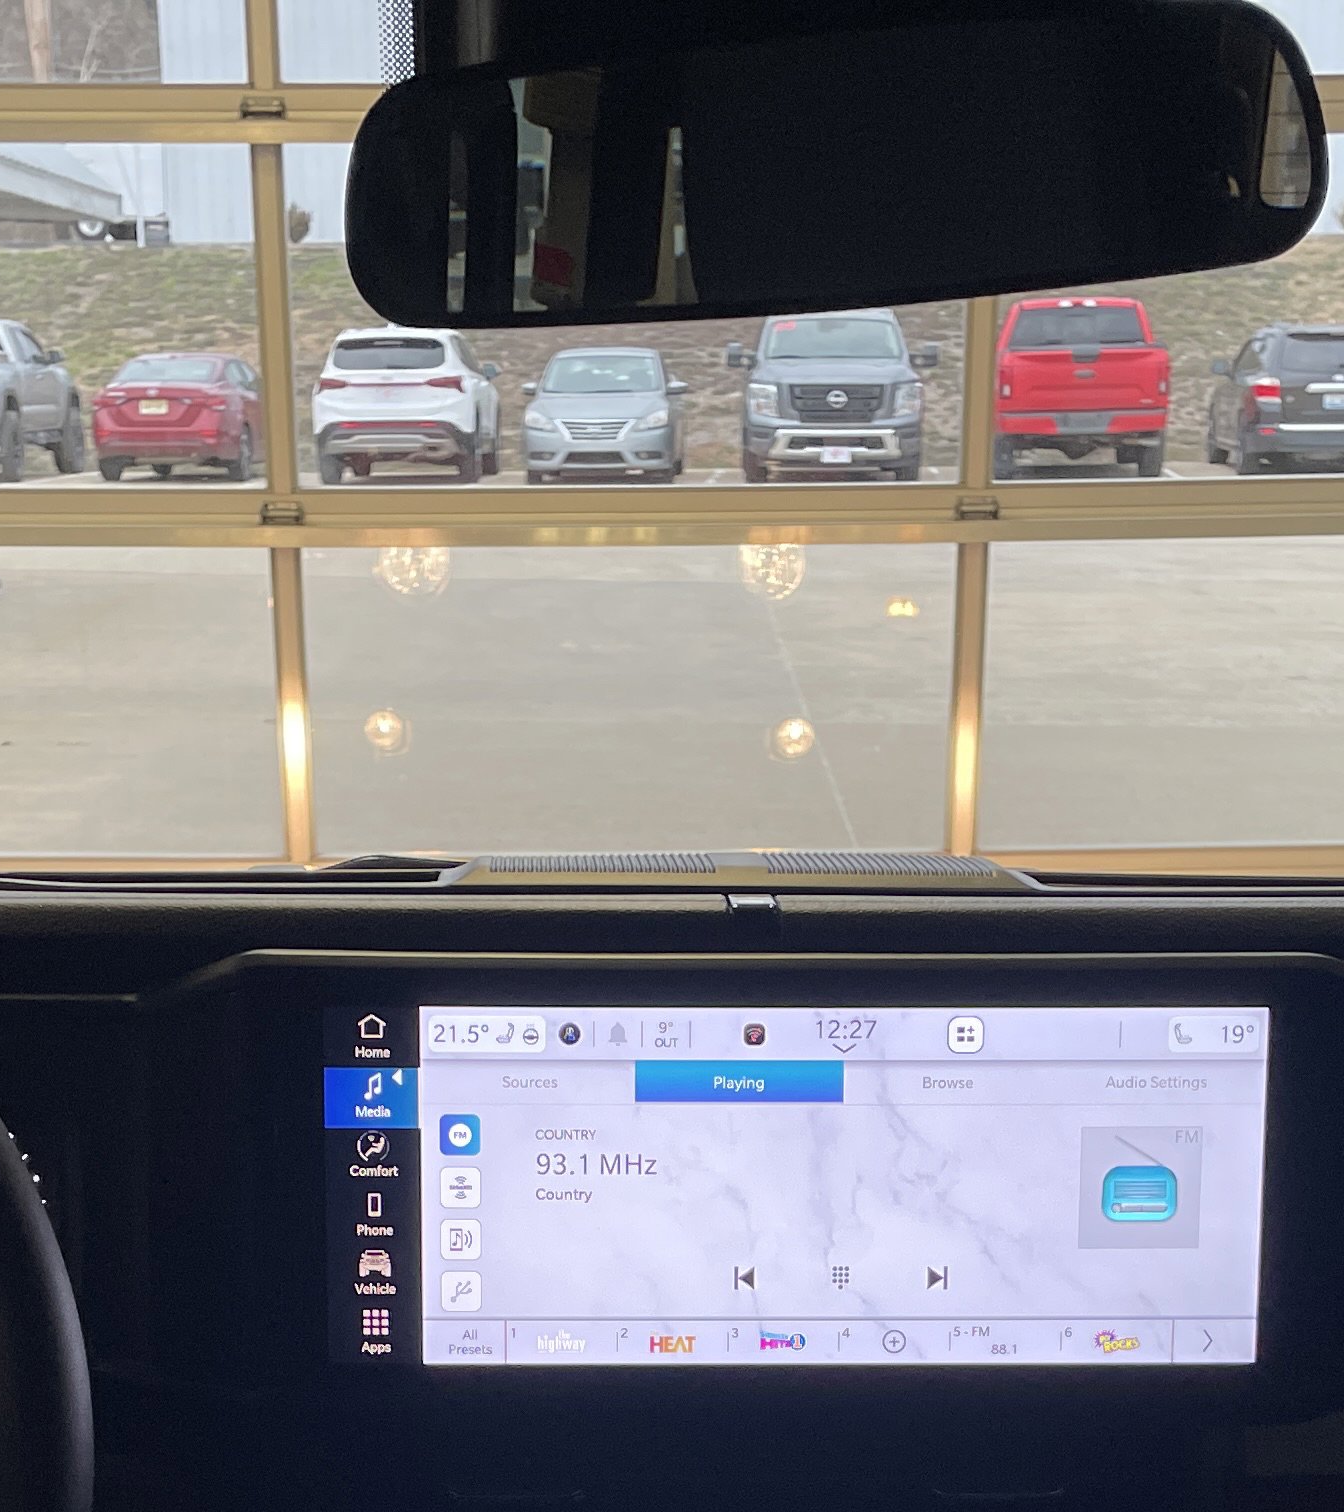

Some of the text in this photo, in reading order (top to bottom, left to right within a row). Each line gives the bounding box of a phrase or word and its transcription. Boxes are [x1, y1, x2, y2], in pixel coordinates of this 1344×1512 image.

[432, 1023, 489, 1044] 21.5°
[815, 1019, 877, 1040] 12:27
[1221, 1024, 1255, 1044] 19°
[654, 1037, 678, 1048] OUT
[354, 1046, 391, 1059] Home
[501, 1075, 558, 1089] Sources
[713, 1076, 765, 1092] Playing
[922, 1076, 974, 1089] Browse
[1105, 1076, 1208, 1091] Audio Settings
[355, 1105, 391, 1118] Media
[453, 1131, 467, 1140] FM
[535, 1129, 597, 1141] COUNTRY
[1175, 1129, 1199, 1144] FM
[536, 1153, 658, 1175] 93.1 MHz
[349, 1165, 399, 1178] Comfort
[535, 1188, 593, 1203] Country
[356, 1224, 394, 1236] Phone
[354, 1283, 397, 1295] Vehicle
[462, 1329, 478, 1341] All
[511, 1328, 516, 1338] 1
[620, 1328, 628, 1338] 2
[731, 1328, 739, 1338] 3
[842, 1327, 850, 1338] 4
[953, 1327, 961, 1337] 5
[972, 1327, 990, 1337] FM
[1064, 1327, 1072, 1338] 6
[361, 1341, 392, 1355] Apps
[448, 1344, 493, 1356] Presets
[537, 1335, 586, 1352] highway
[649, 1336, 696, 1353] HEAT
[991, 1344, 1017, 1355] 88.1
